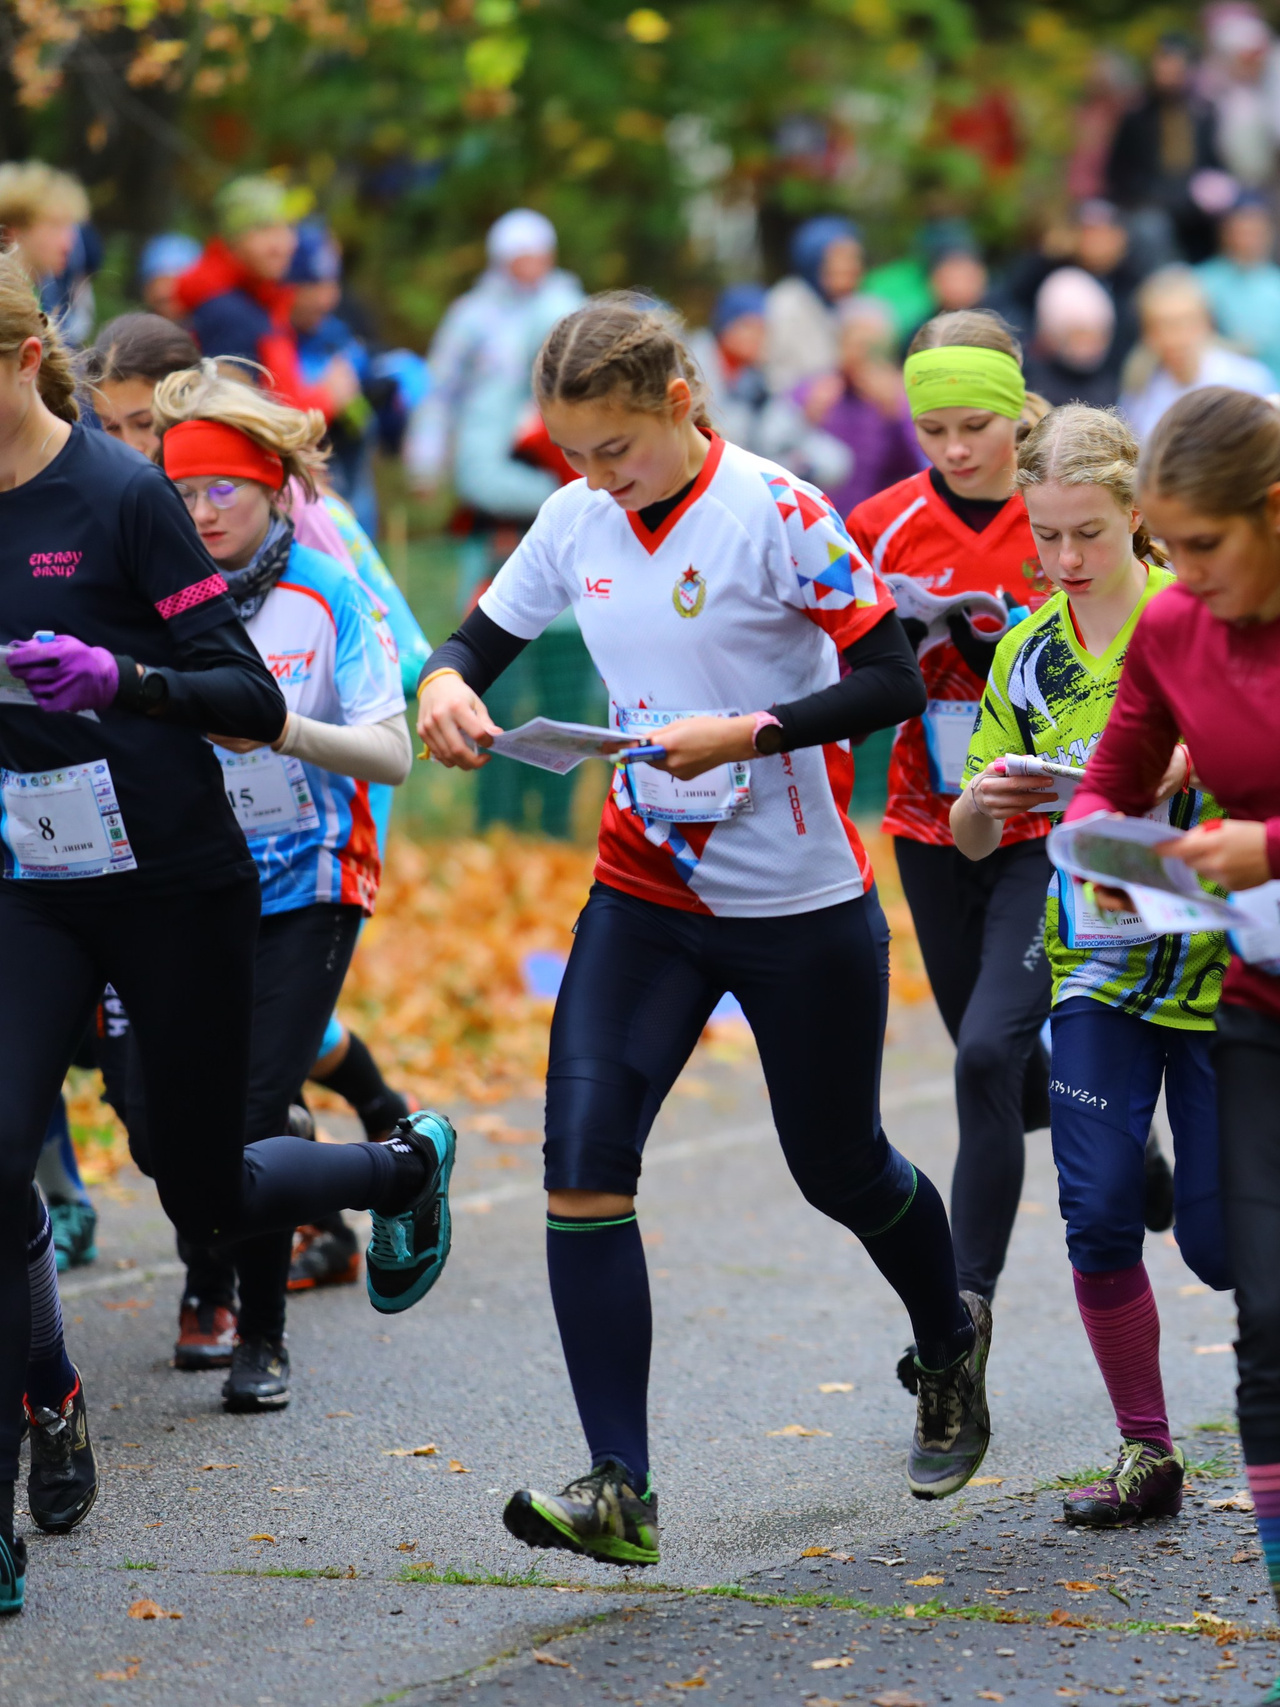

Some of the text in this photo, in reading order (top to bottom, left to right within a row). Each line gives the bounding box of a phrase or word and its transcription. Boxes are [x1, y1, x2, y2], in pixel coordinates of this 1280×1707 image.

[32, 565, 76, 578] GROUP
[585, 577, 613, 594] VC
[228, 788, 254, 808] 15
[683, 789, 717, 798] линия
[788, 785, 806, 836] CODE
[38, 816, 55, 841] 8
[62, 842, 94, 852] линия
[1115, 933, 1158, 946] СОРЕВНОВАНИЯ
